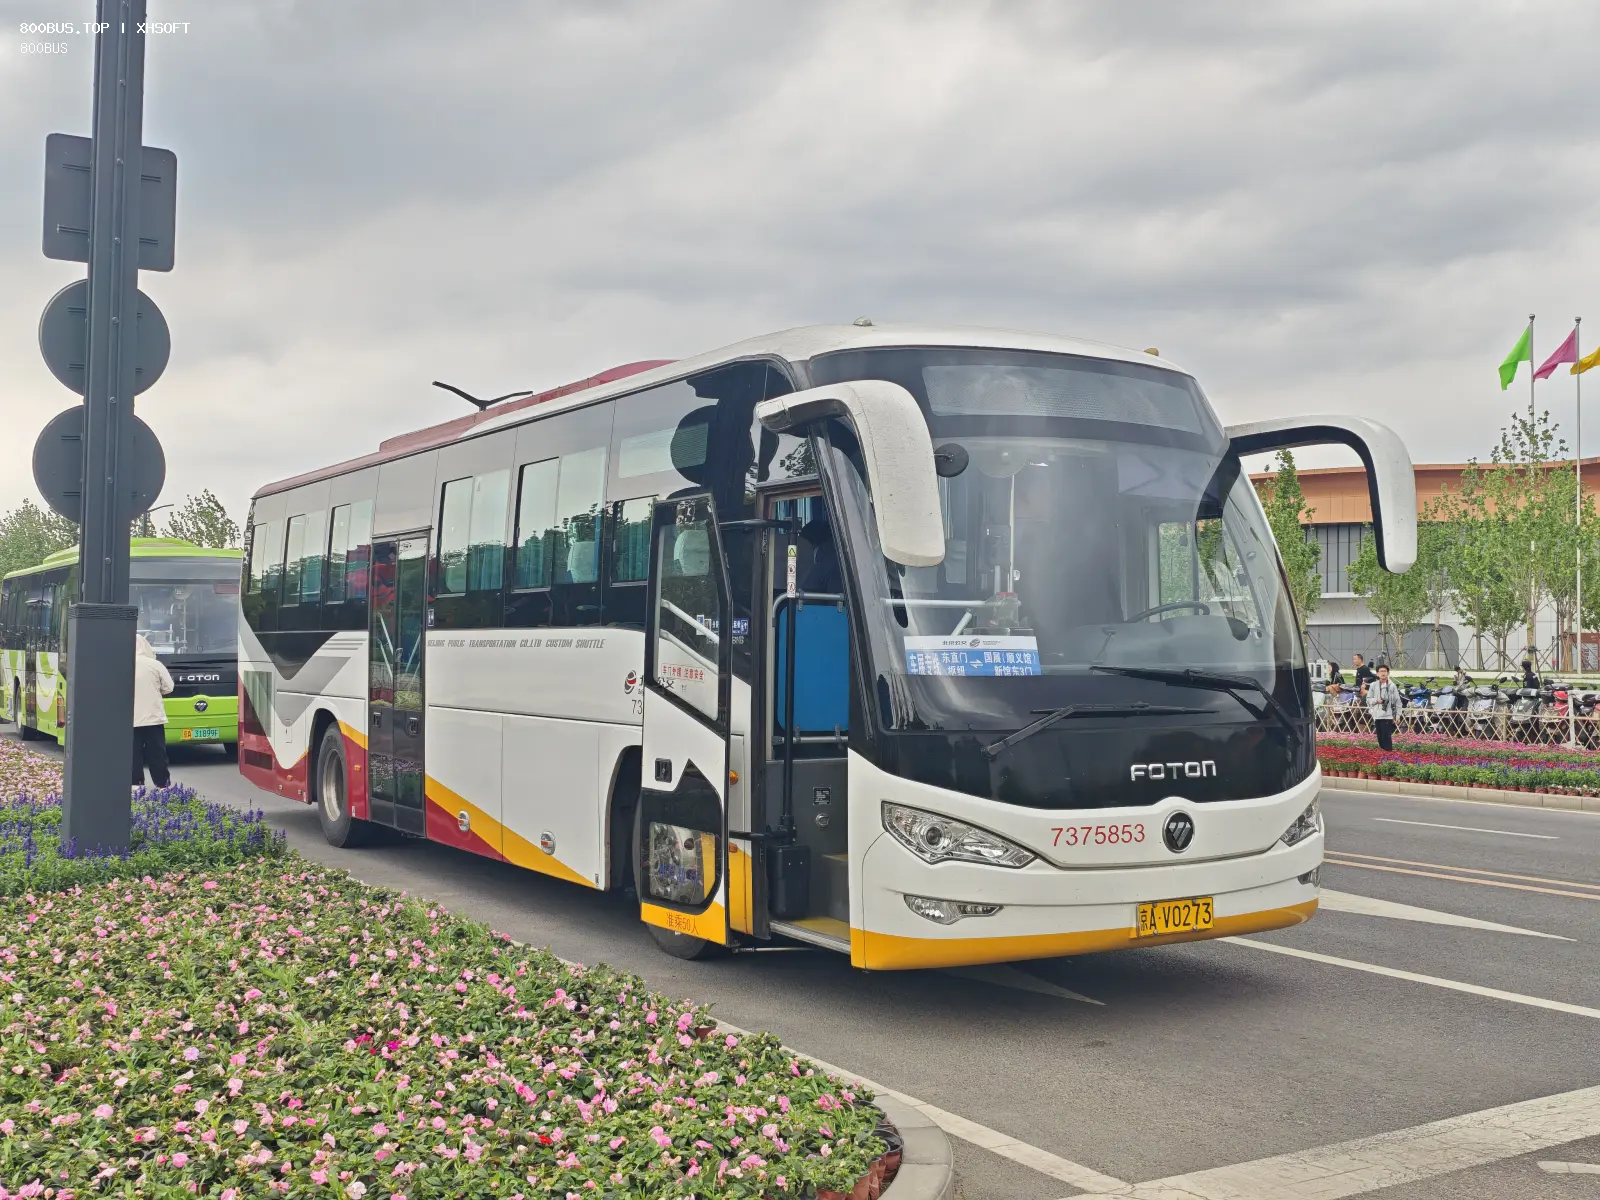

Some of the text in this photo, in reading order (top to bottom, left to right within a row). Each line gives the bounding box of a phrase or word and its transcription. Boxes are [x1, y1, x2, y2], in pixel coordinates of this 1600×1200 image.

[447, 639, 466, 648] PUBLIC
[468, 639, 518, 648] TRANSPORTATION
[545, 638, 573, 648] CUSTOM
[575, 638, 606, 649] SHUTTLE
[940, 651, 969, 664] 东直门
[179, 674, 220, 682] FOTON
[1130, 760, 1217, 782] FOTON
[1050, 823, 1146, 847] 7375853
[666, 912, 699, 935] 准乘50人
